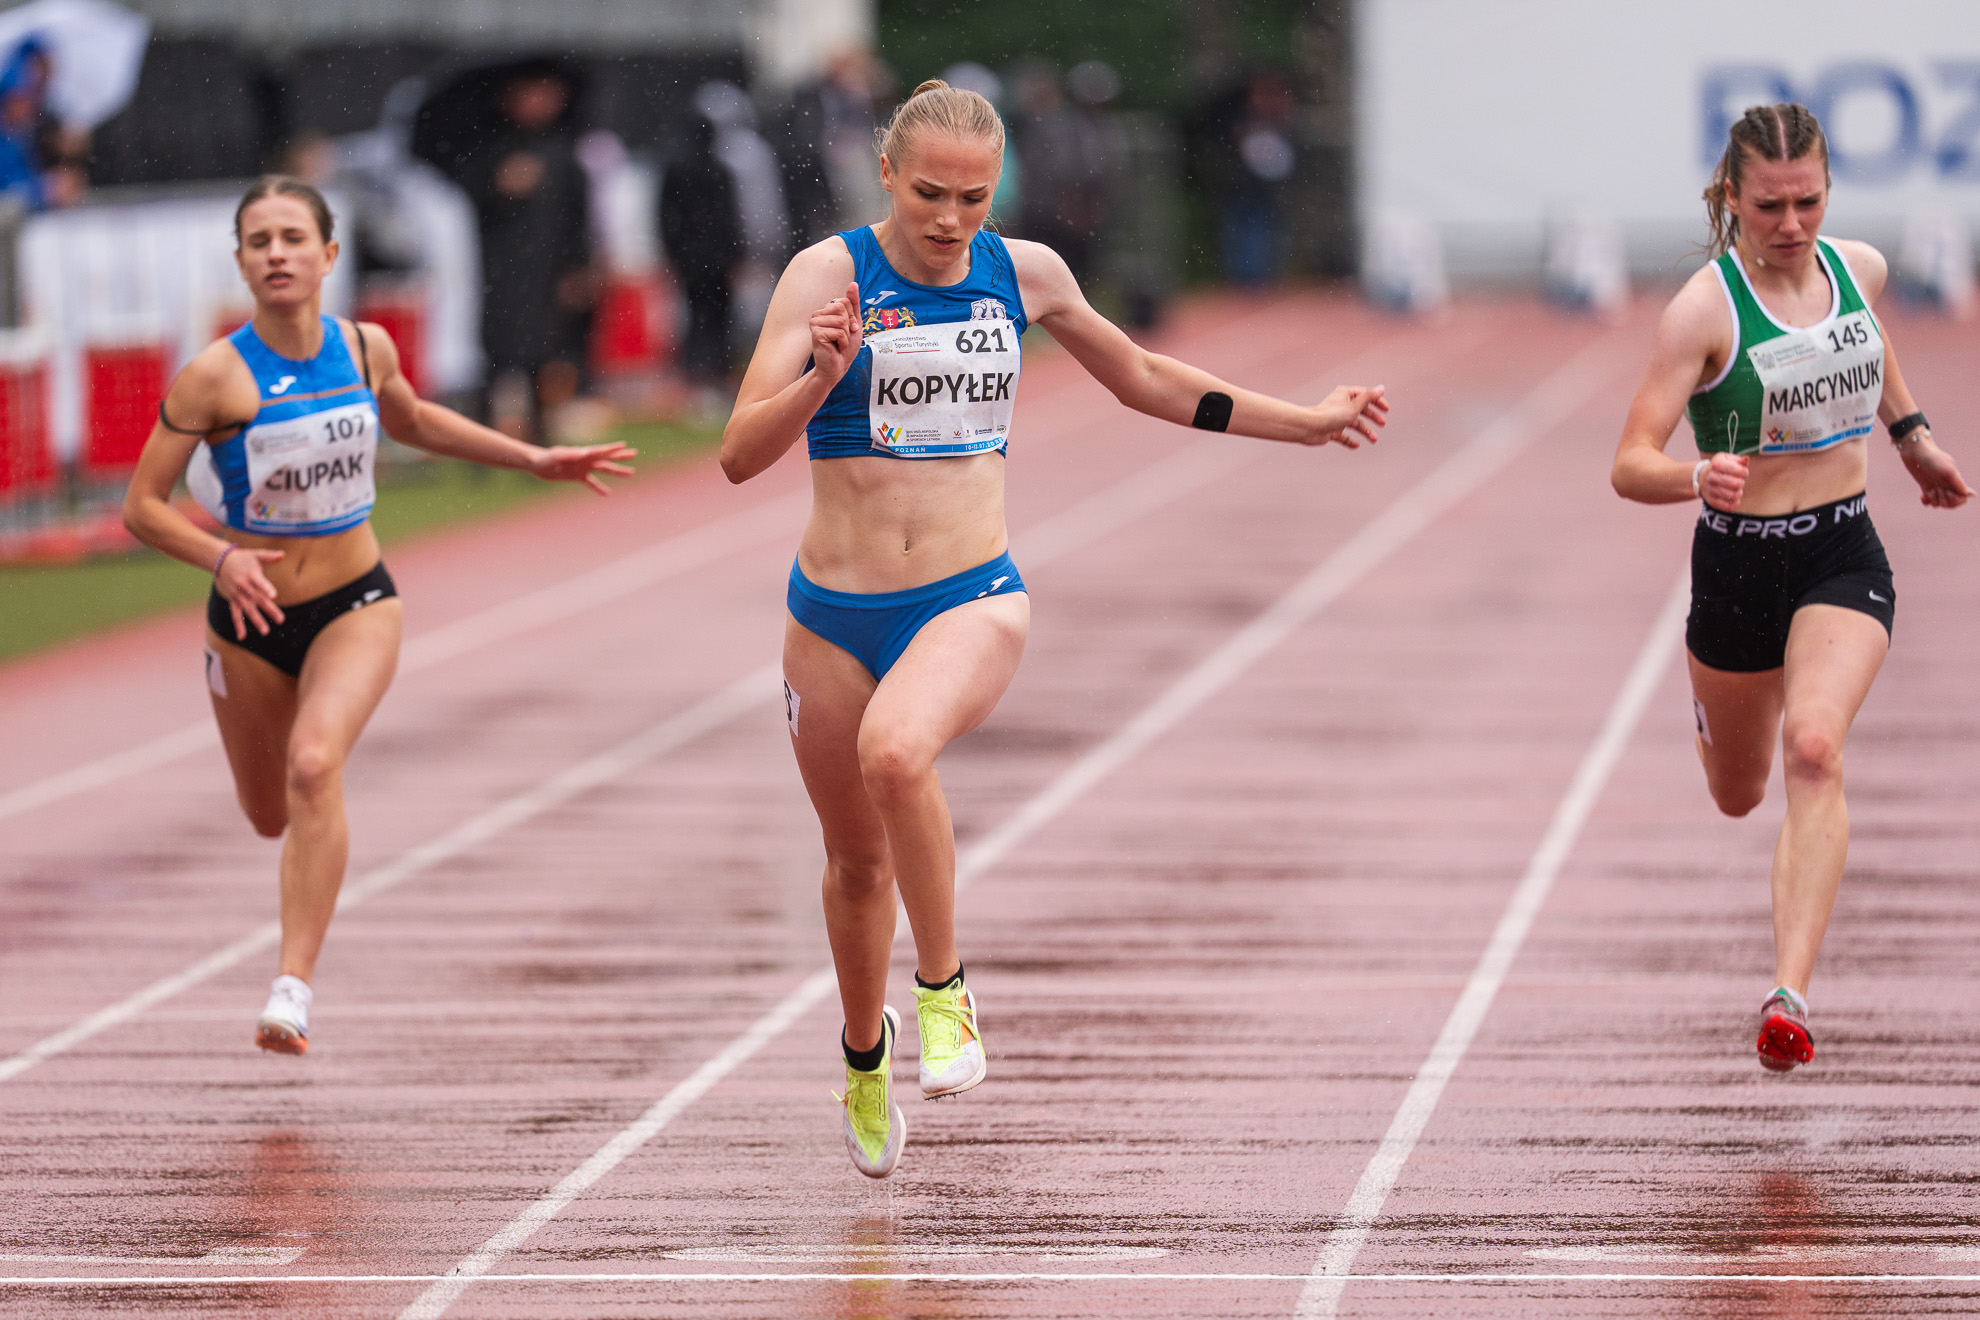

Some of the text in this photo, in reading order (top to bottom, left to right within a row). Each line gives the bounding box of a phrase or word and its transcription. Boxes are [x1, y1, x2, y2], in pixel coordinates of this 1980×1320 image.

[956, 328, 1008, 354] 621
[1828, 322, 1868, 353] 145
[877, 372, 1014, 406] KOPYŁEK
[1769, 358, 1880, 415] MARCYNIUK
[324, 415, 365, 443] 107
[265, 452, 364, 491] CIUPAK
[1736, 514, 1818, 540] PRO
